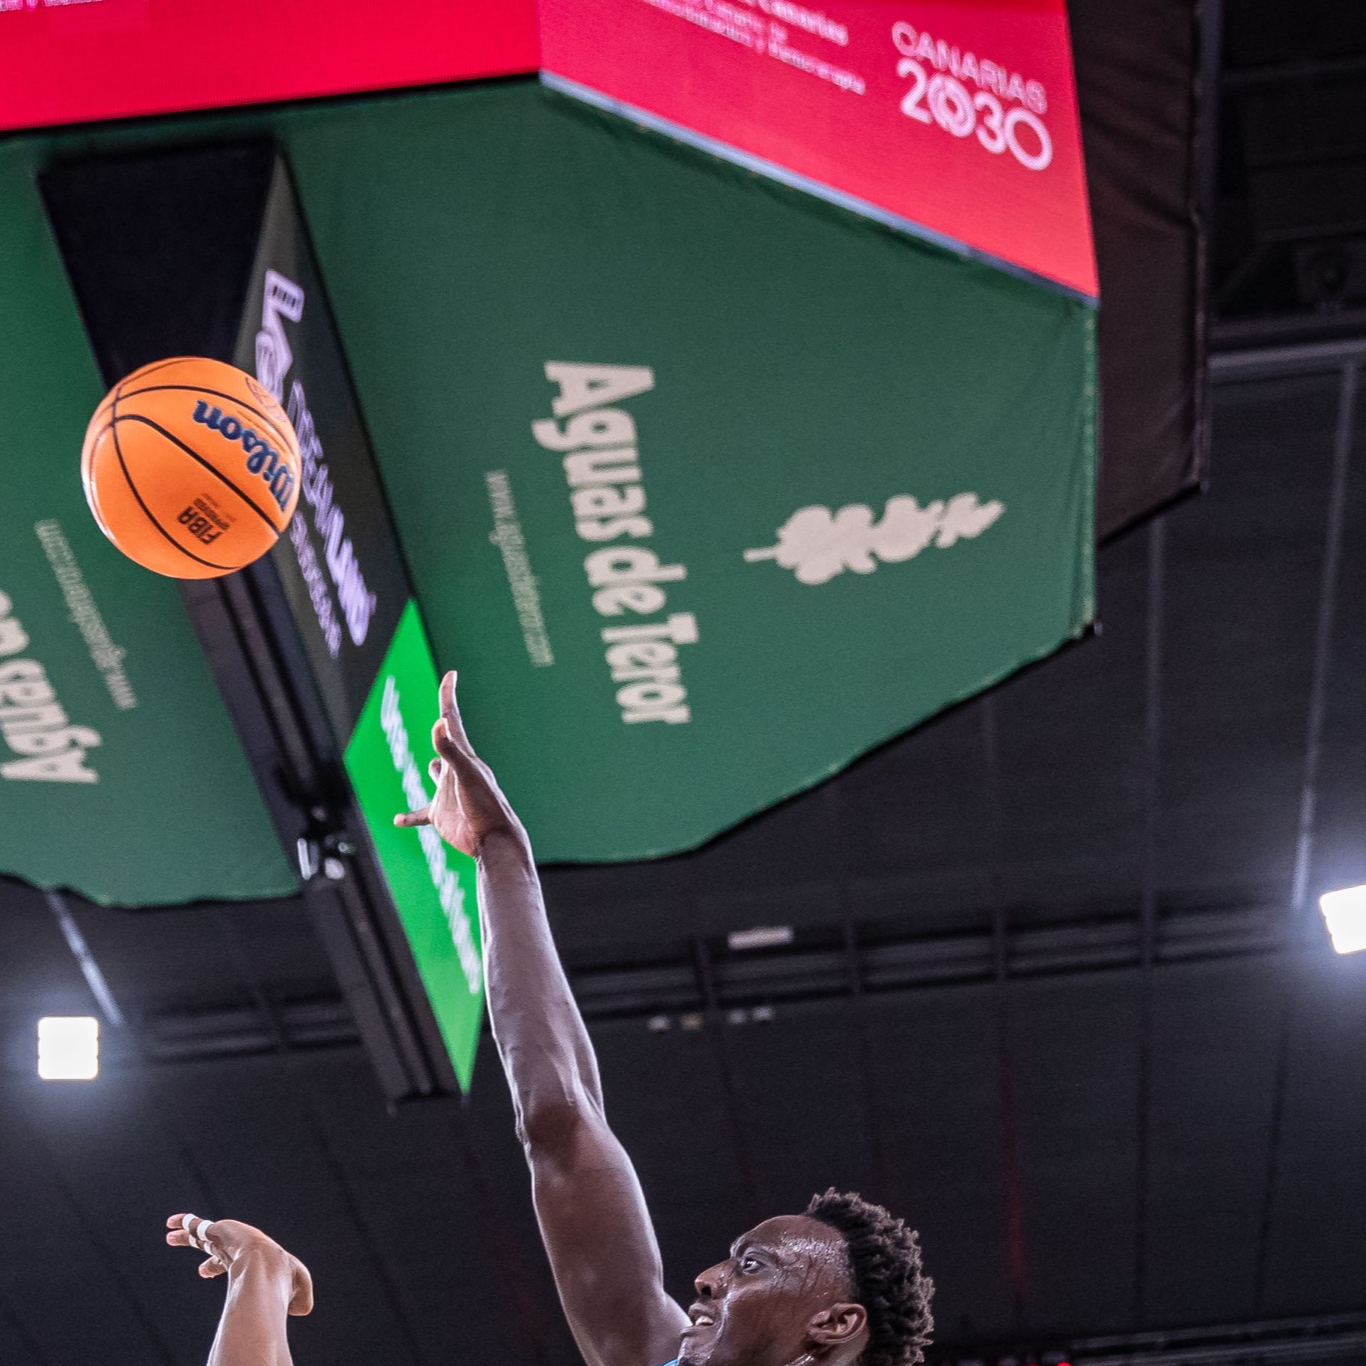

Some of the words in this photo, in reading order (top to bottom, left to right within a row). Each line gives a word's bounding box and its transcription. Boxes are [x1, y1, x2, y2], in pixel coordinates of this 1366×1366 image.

[891, 21, 1047, 115] CANARIAS
[896, 58, 1053, 171] 2030
[193, 400, 293, 512] Wilson
[531, 360, 655, 541] Aguas
[177, 506, 223, 544] FIBA
[585, 546, 687, 617] de
[601, 612, 699, 724] Teror
